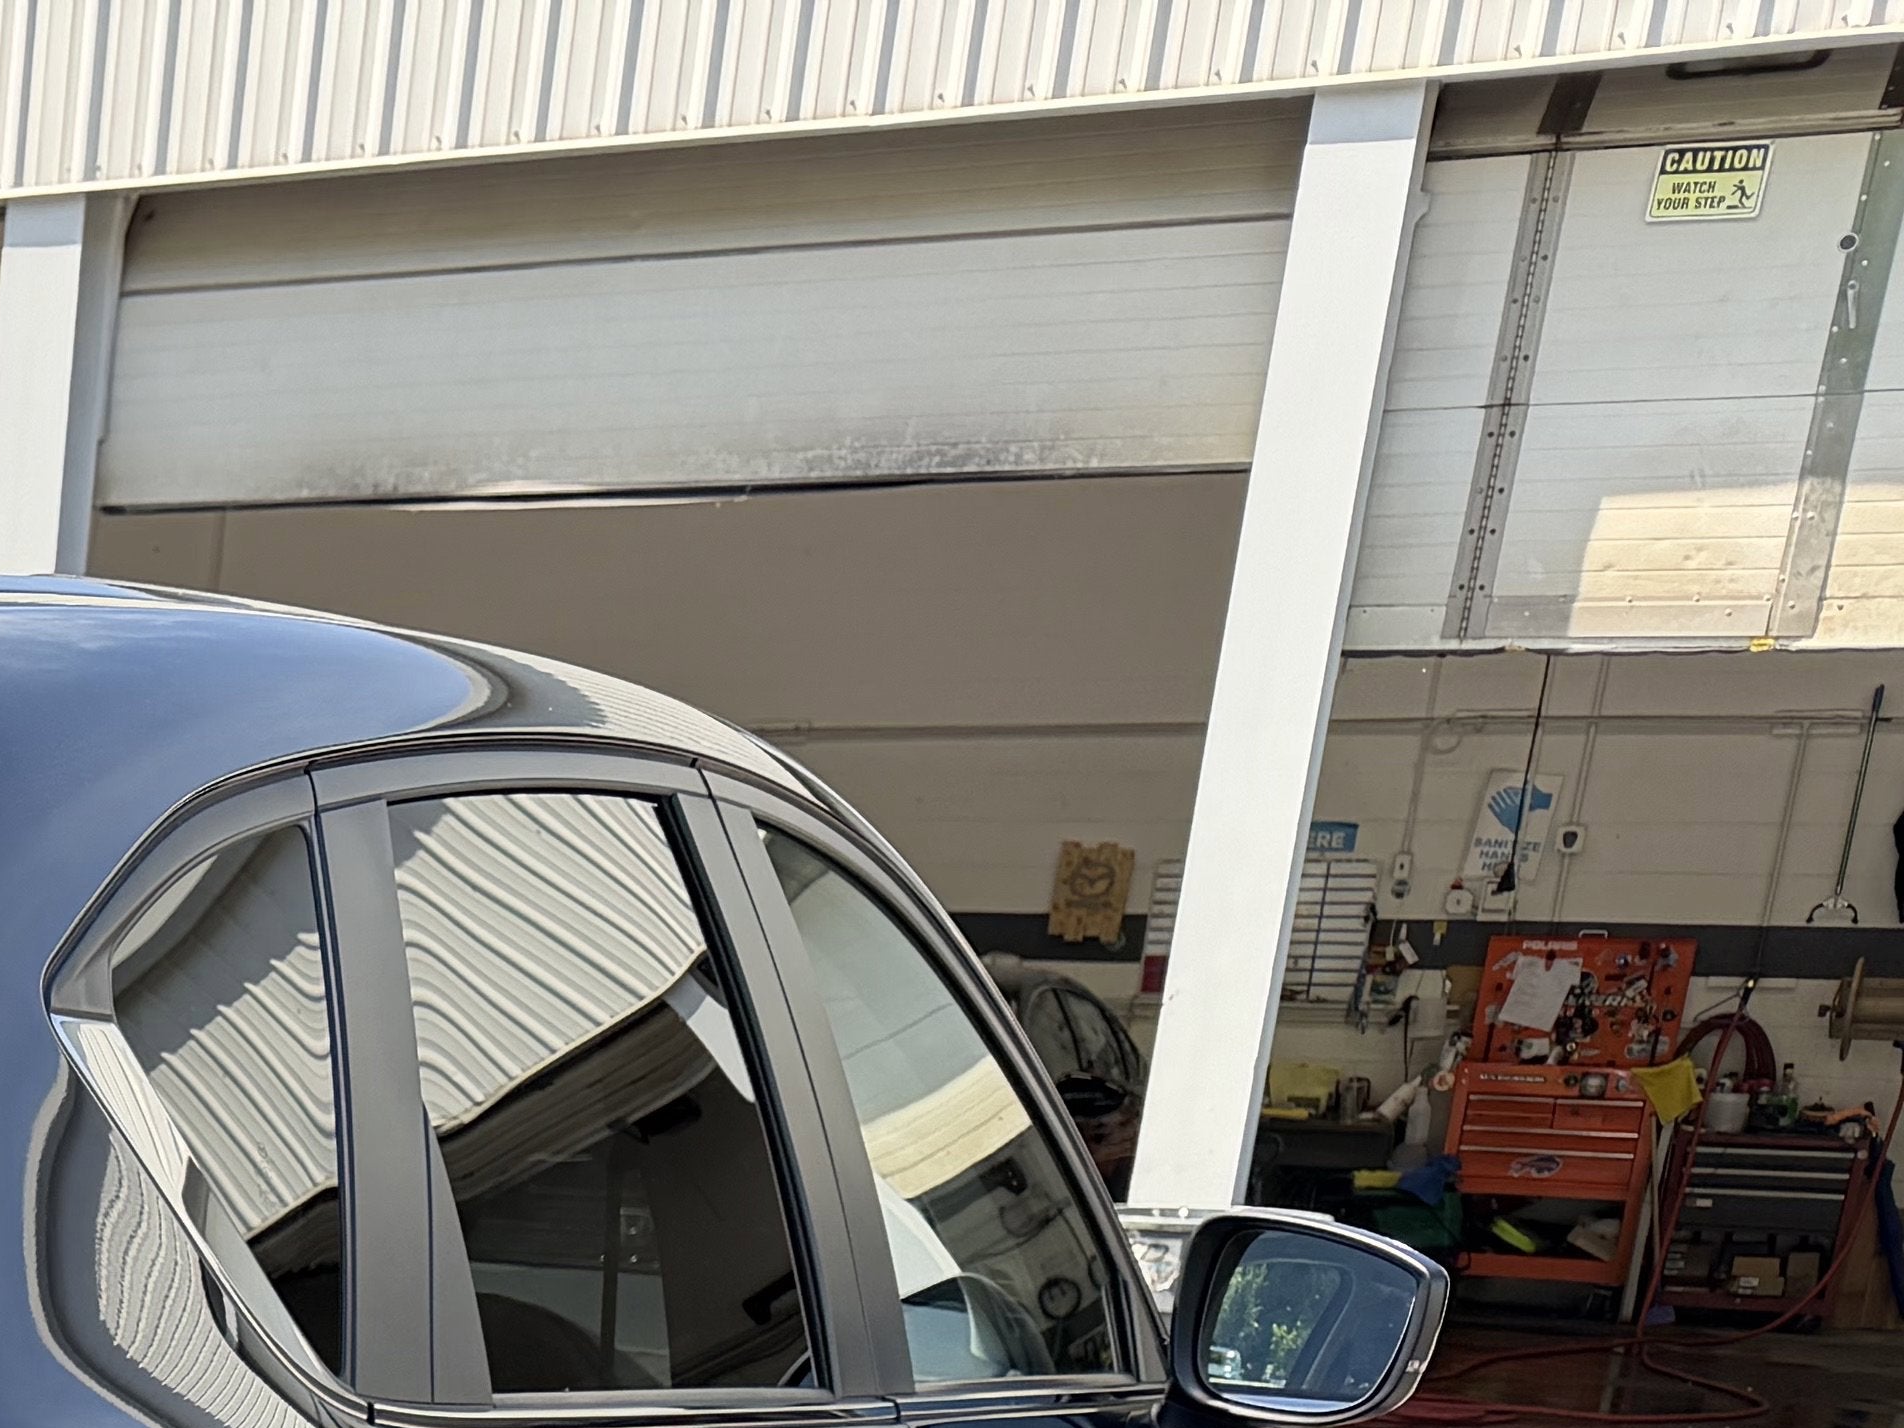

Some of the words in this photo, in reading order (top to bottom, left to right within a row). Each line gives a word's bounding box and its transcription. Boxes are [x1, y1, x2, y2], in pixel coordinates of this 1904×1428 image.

[1665, 148, 1765, 172] CAUTION
[1672, 181, 1717, 194] WATCH
[1656, 198, 1690, 210] YOUR
[1694, 195, 1727, 209] STEP
[1474, 837, 1542, 853] SANIZE
[1479, 849, 1529, 862] HANS
